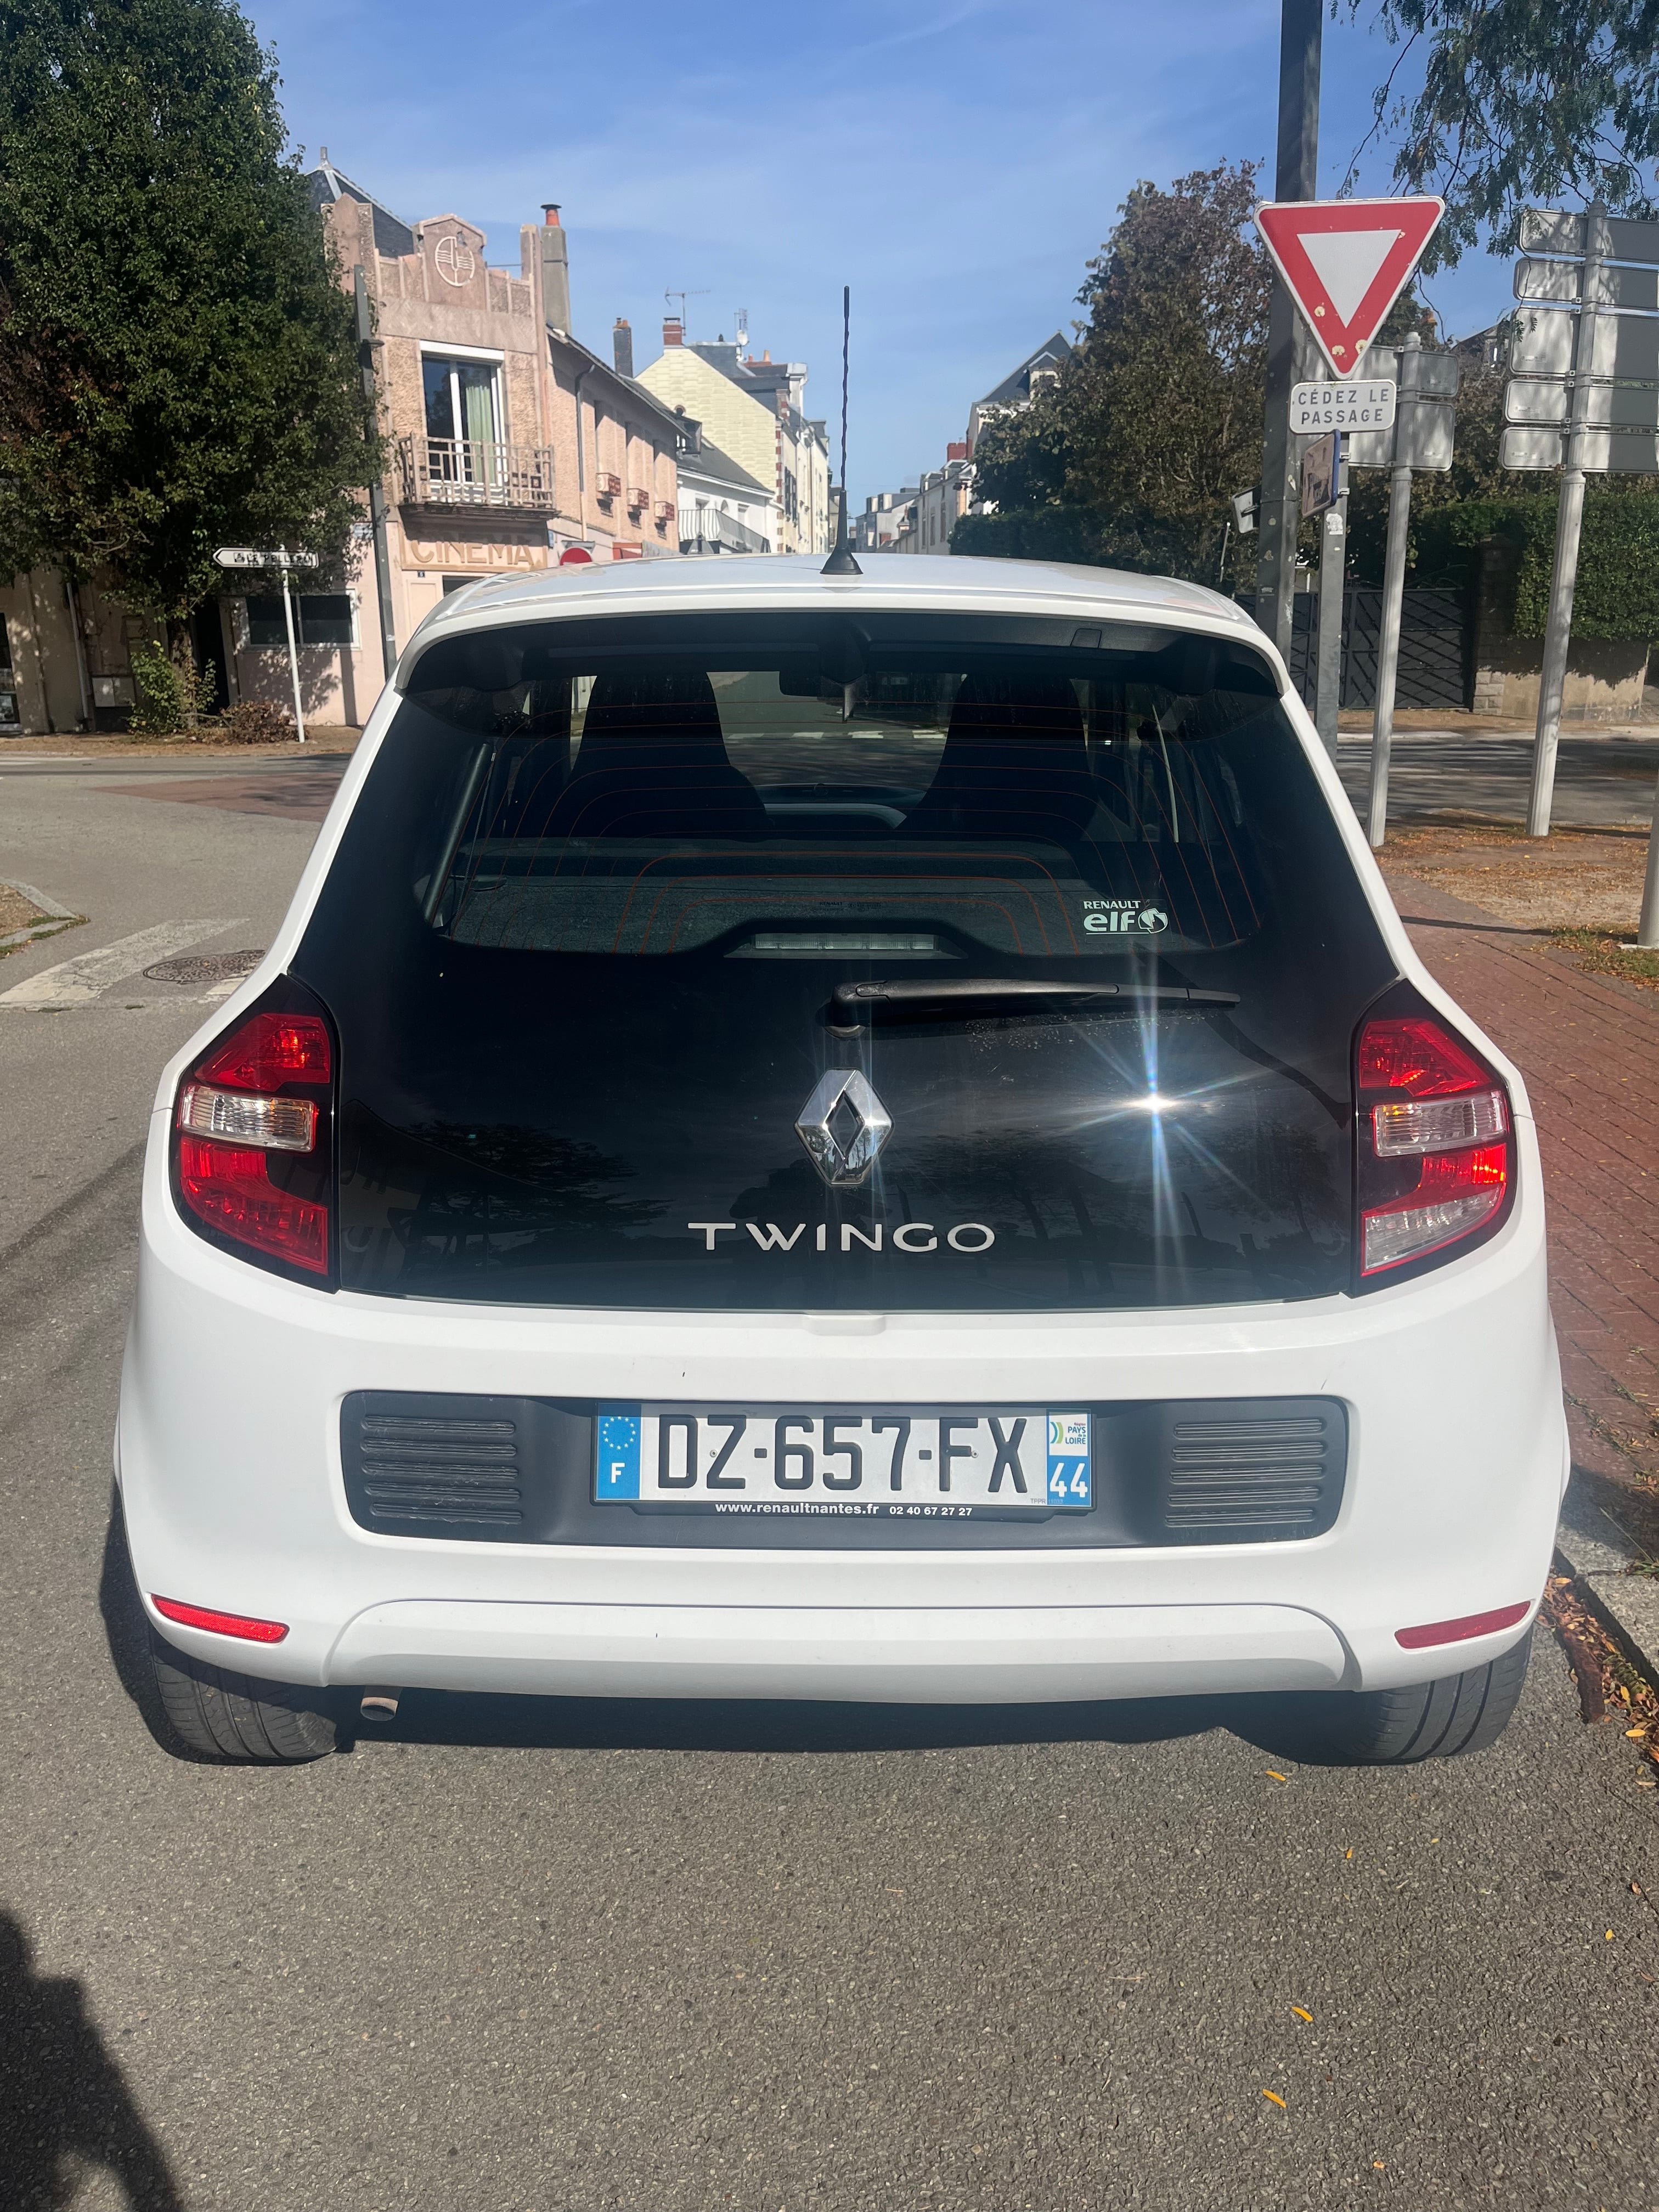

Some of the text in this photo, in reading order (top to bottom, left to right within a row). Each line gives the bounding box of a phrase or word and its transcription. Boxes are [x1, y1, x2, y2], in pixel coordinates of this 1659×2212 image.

[1298, 388, 1389, 405] CÉDEZ LE
[1301, 409, 1383, 425] PASSAGE
[410, 535, 534, 565] CINEMA
[1084, 900, 1141, 909] RENAULT
[1084, 911, 1136, 932] elf
[687, 1223, 995, 1252] TWINGO
[658, 1414, 1028, 1493] DZ-657-FX
[611, 1463, 625, 1483] F
[1049, 1462, 1088, 1498] 44
[715, 1502, 973, 1516] www.renaultnantes.fr 02 40 67 27 27
